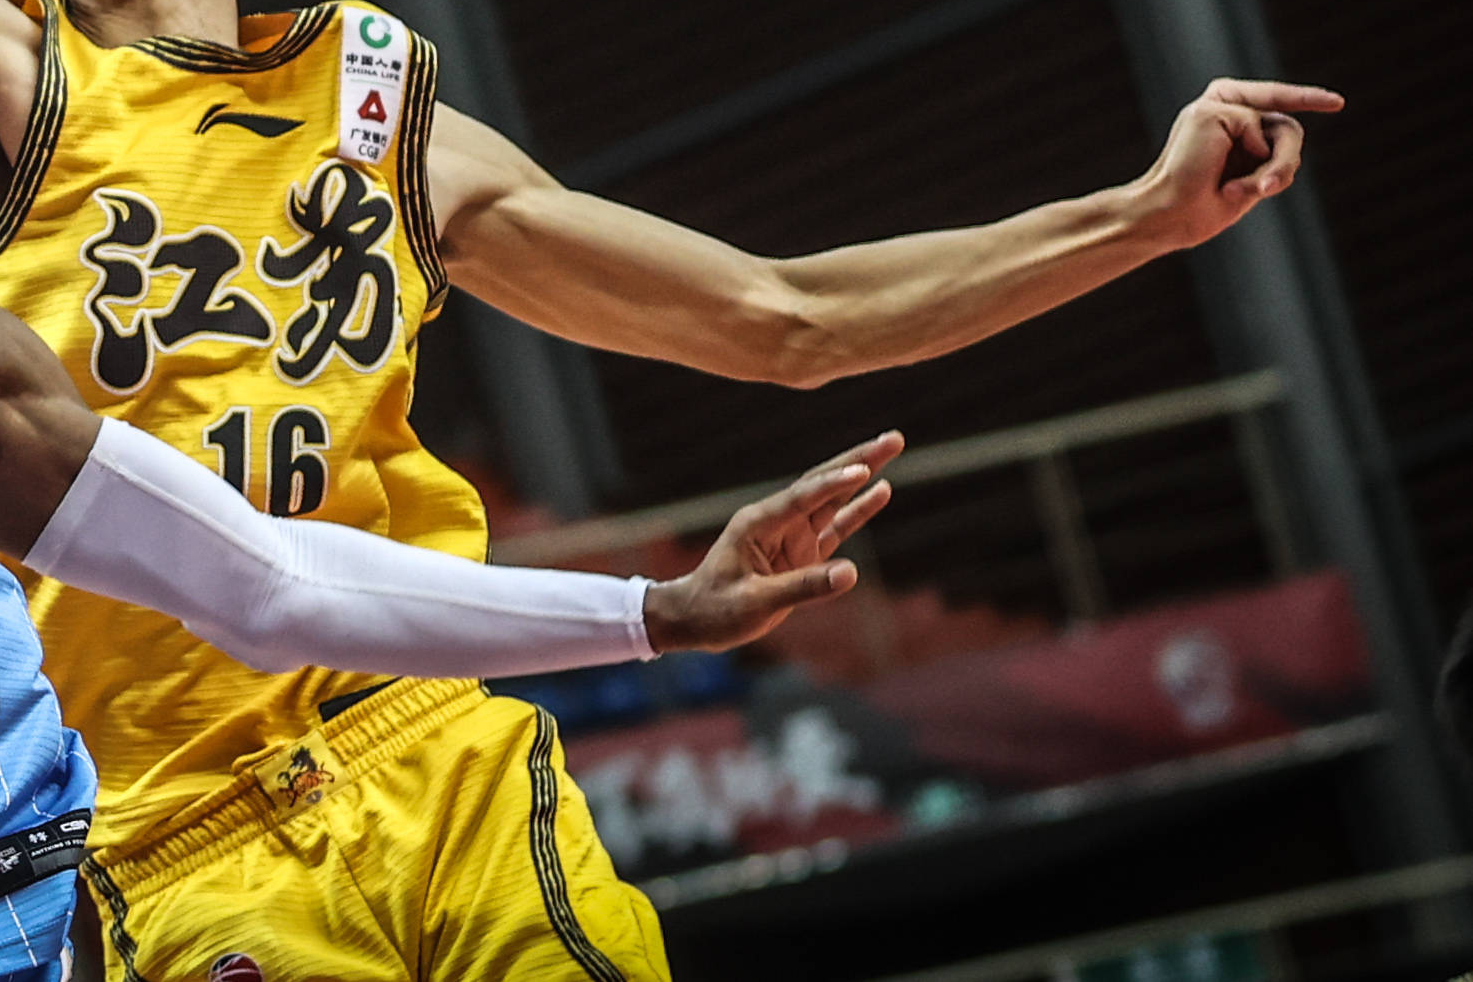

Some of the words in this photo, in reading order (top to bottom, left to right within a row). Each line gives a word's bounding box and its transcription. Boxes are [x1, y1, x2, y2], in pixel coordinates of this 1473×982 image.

[345, 67, 377, 75] CHINA
[80, 159, 398, 394] 江苏
[203, 405, 330, 518] 16
